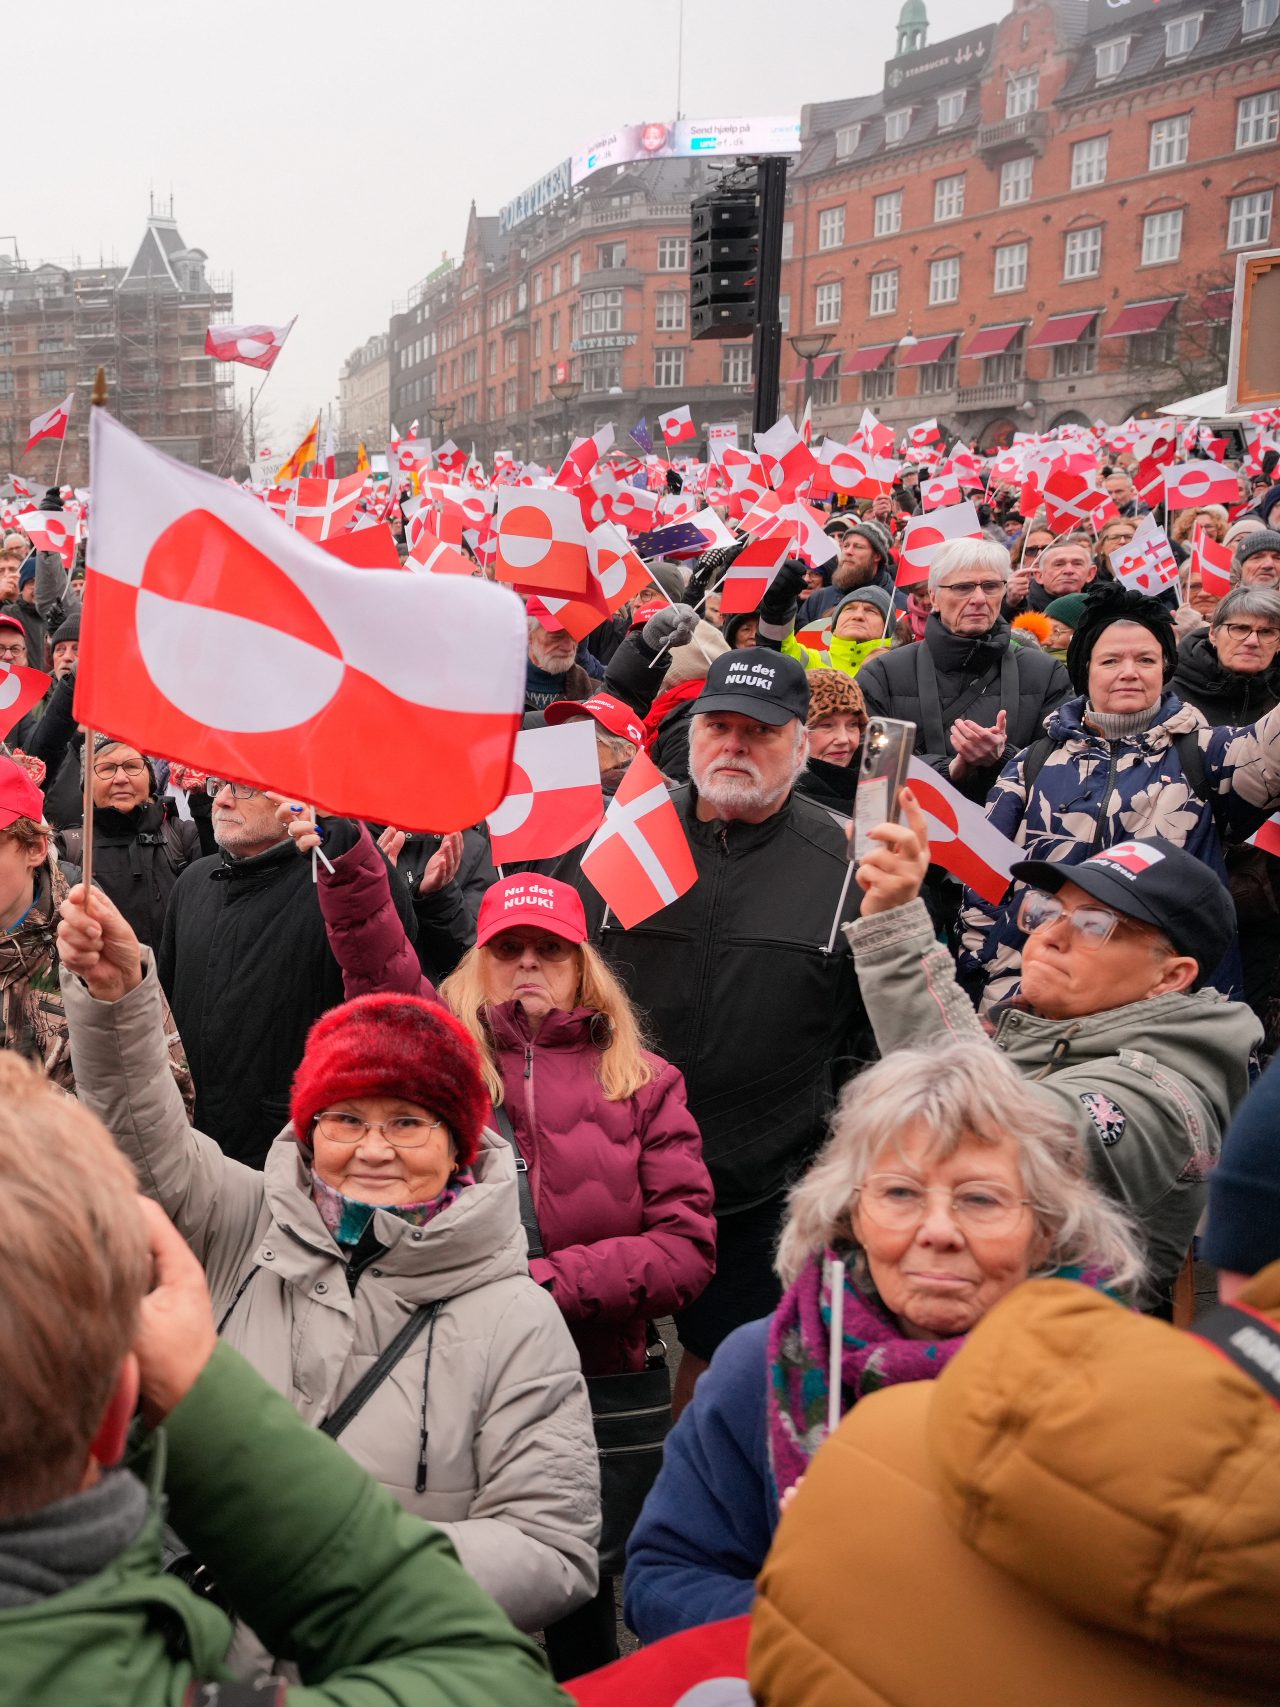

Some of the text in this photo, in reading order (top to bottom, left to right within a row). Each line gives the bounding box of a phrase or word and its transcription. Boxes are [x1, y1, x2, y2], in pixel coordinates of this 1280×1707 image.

[905, 57, 949, 77] STARBUCKS
[690, 123, 751, 135] Send hjælp på
[499, 157, 571, 237] POLITIKEN
[728, 662, 776, 678] Nu det
[724, 674, 773, 691] NUUK!
[1110, 862, 1138, 882] Great
[504, 884, 554, 898] Nu det
[504, 895, 554, 910] NUUK!
